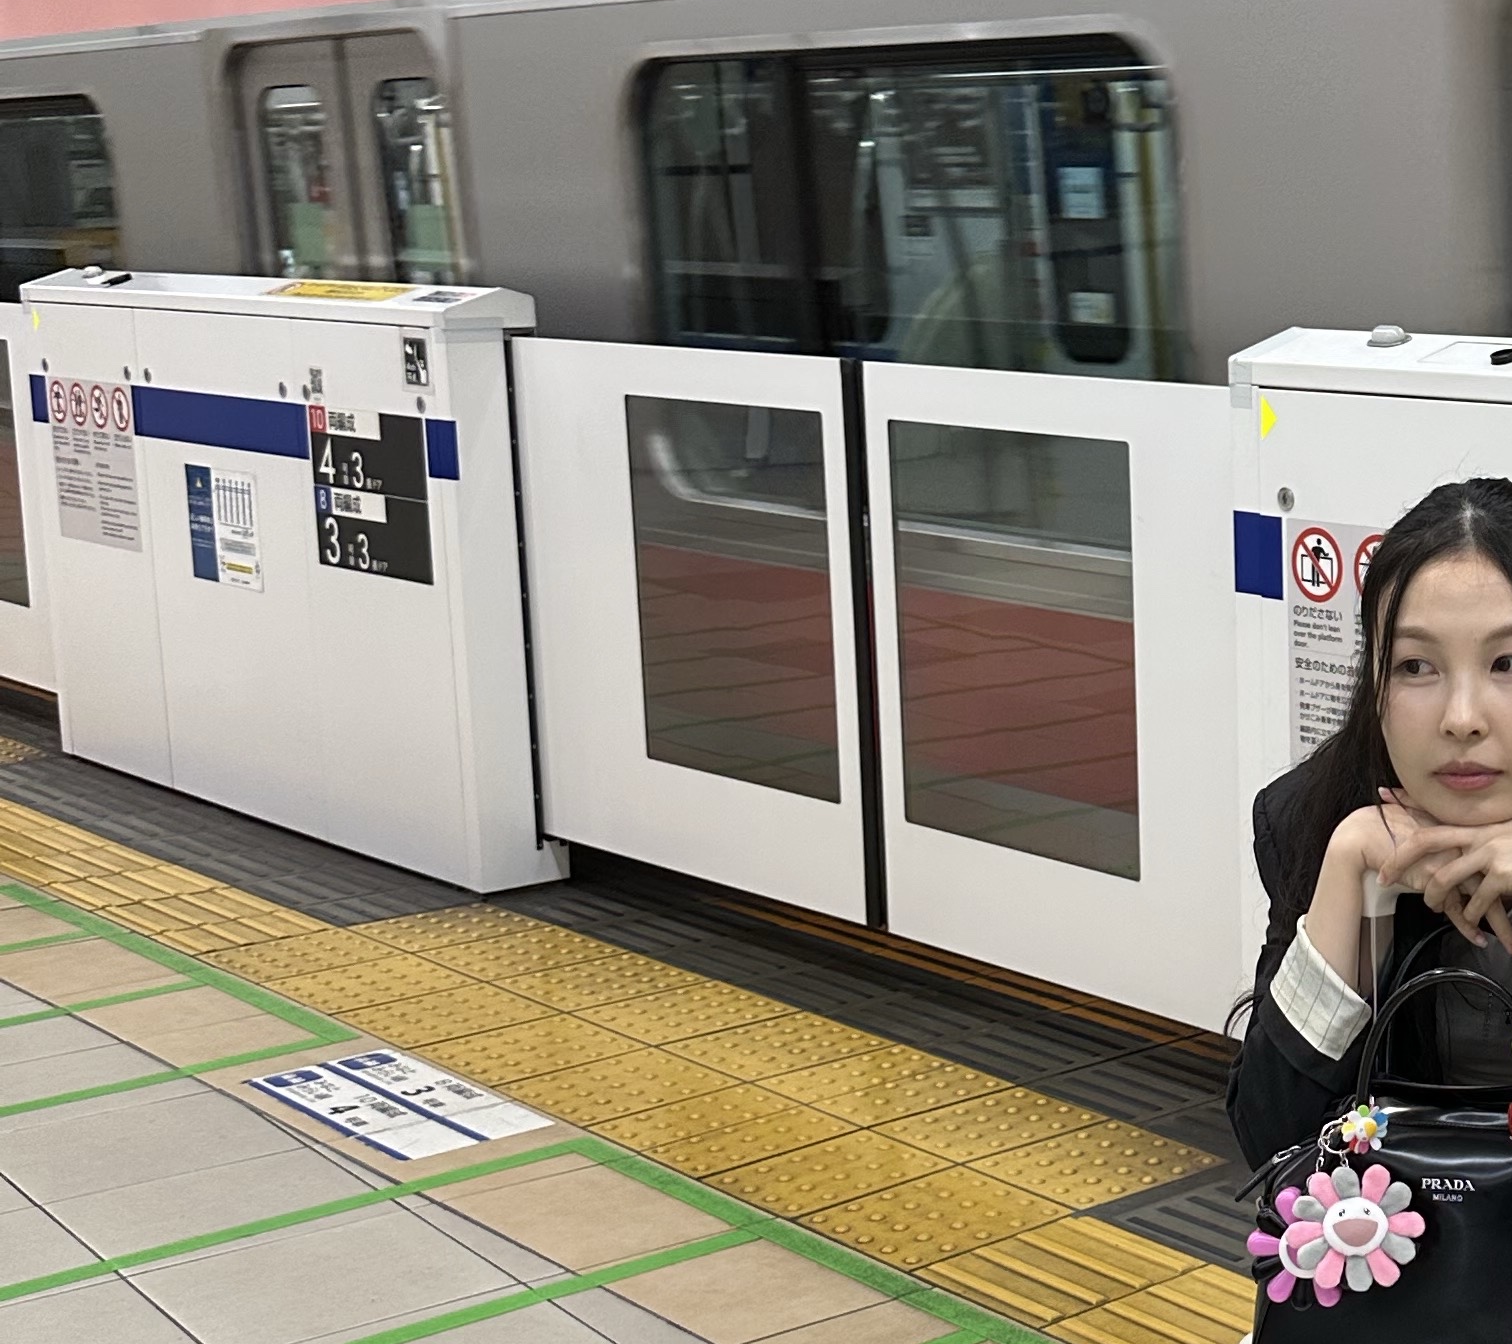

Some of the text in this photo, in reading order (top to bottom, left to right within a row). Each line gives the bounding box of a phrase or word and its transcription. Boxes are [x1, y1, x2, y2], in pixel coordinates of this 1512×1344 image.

[310, 409, 324, 429] 10
[319, 438, 336, 484] 4
[352, 452, 364, 488] 3
[318, 490, 327, 510] 8
[325, 517, 341, 565] 3
[357, 533, 370, 570] 3
[401, 1086, 435, 1095] 3
[328, 1105, 360, 1114] 4
[1421, 1177, 1476, 1192] PRADA
[1432, 1193, 1463, 1203] MILANO
